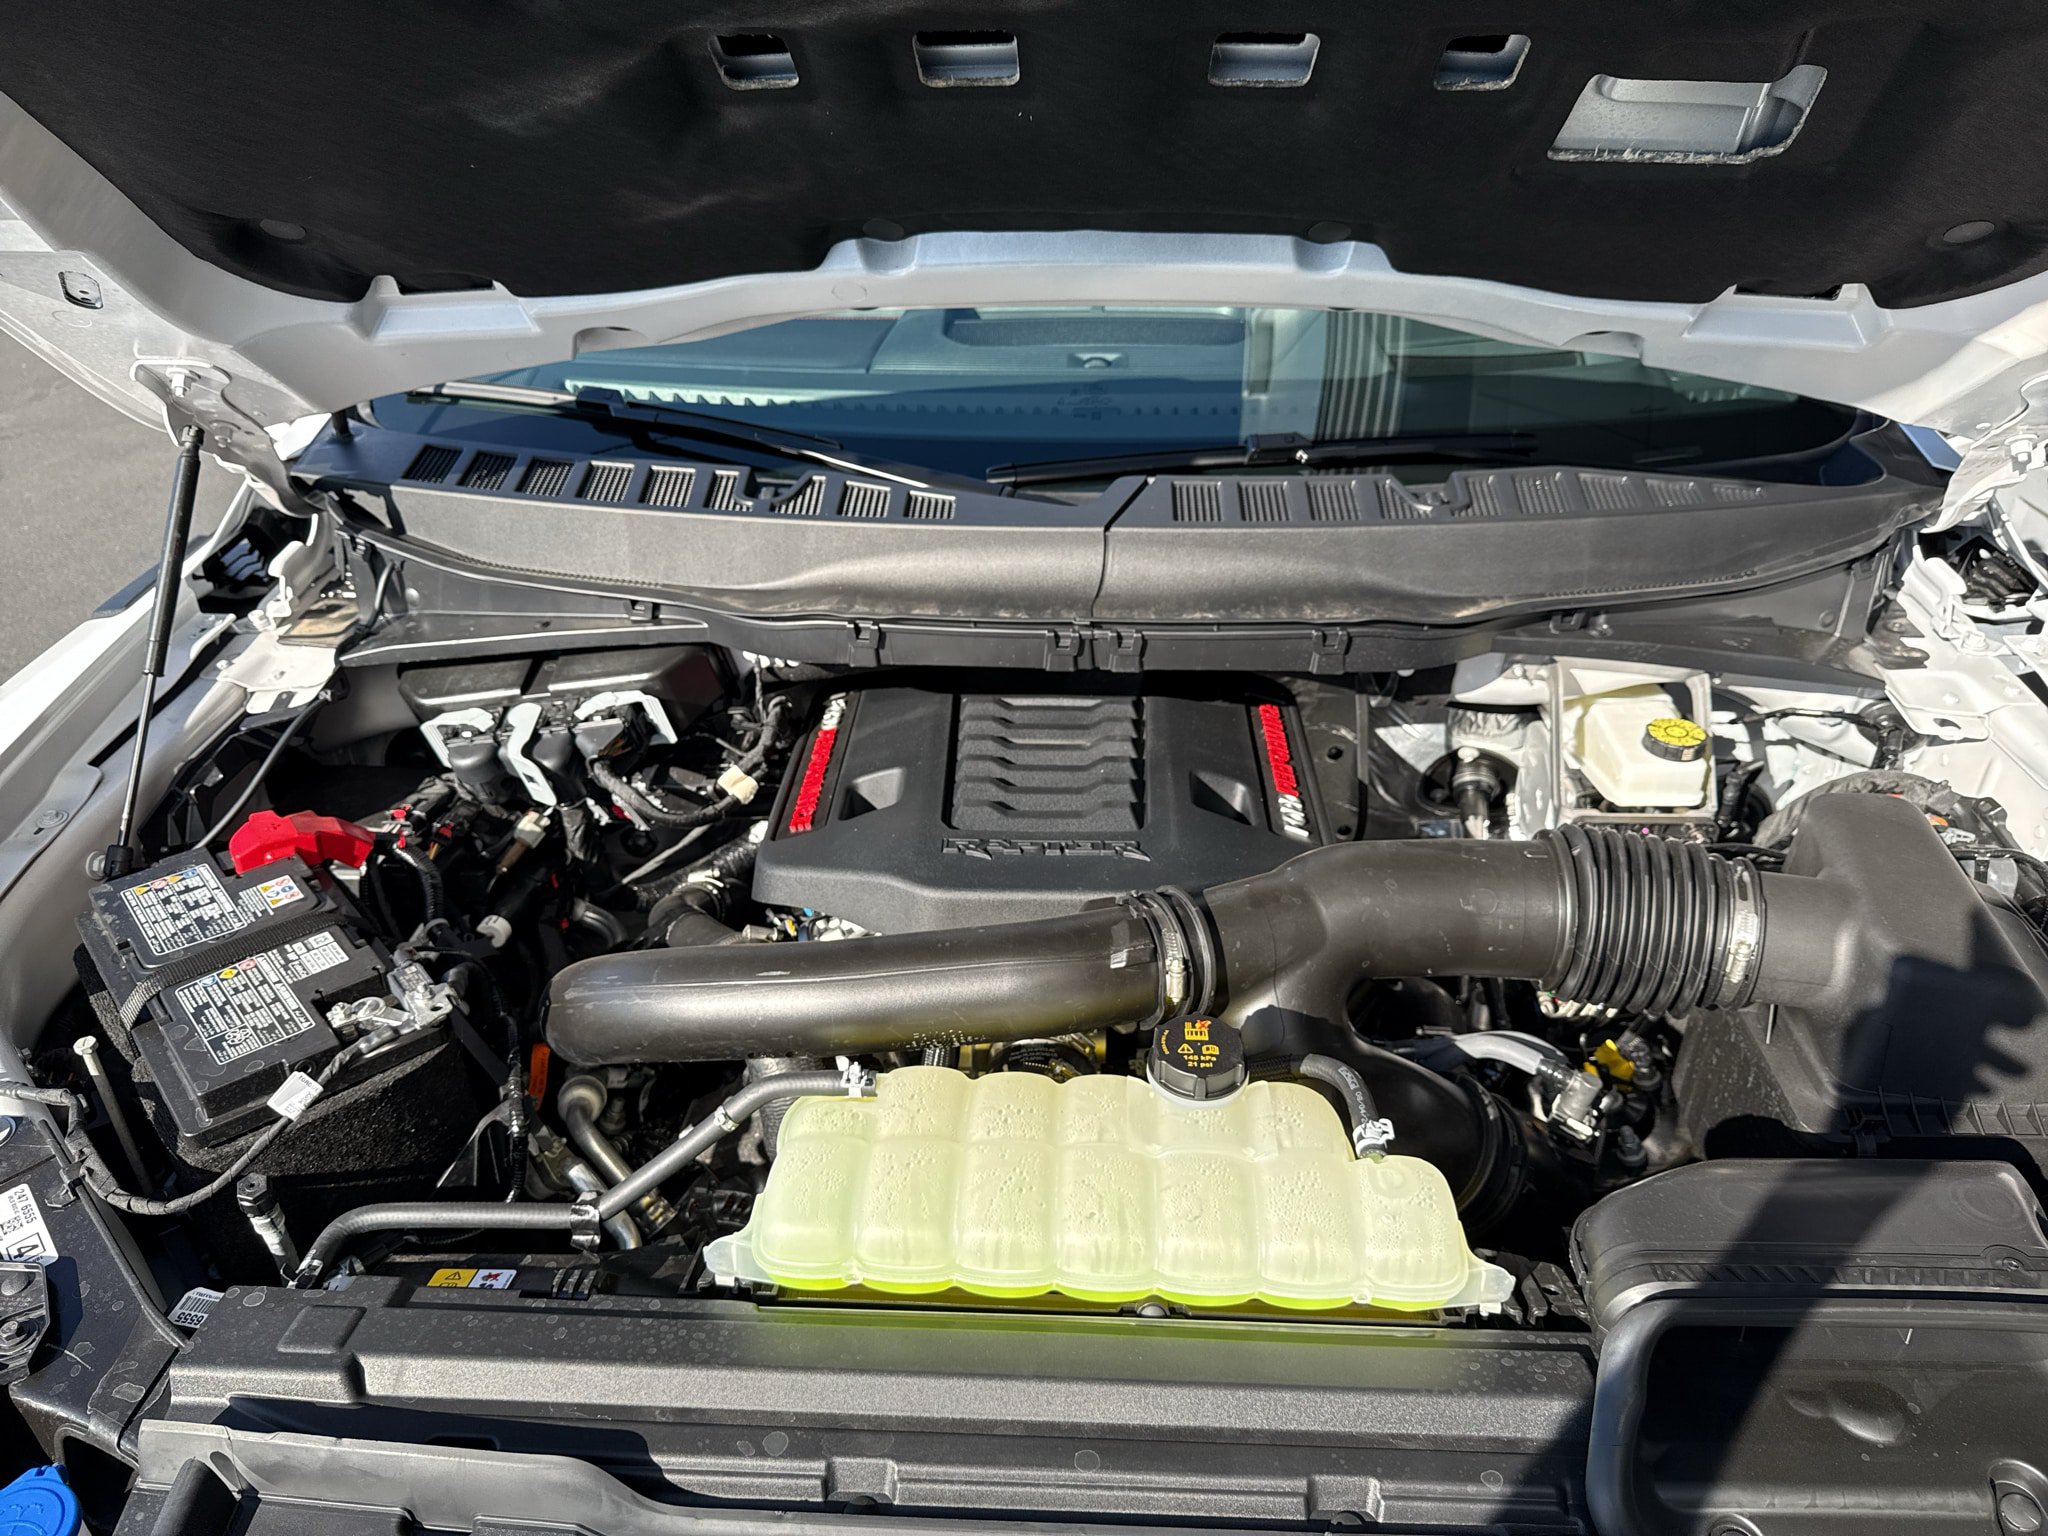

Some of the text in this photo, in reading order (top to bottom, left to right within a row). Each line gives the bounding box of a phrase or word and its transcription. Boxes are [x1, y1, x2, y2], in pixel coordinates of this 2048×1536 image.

[941, 837, 1152, 862] RAPTOR
[13, 1188, 29, 1204] 247
[20, 1203, 37, 1224] 6555
[13, 1244, 39, 1260] 4
[174, 1312, 204, 1325] 6555
